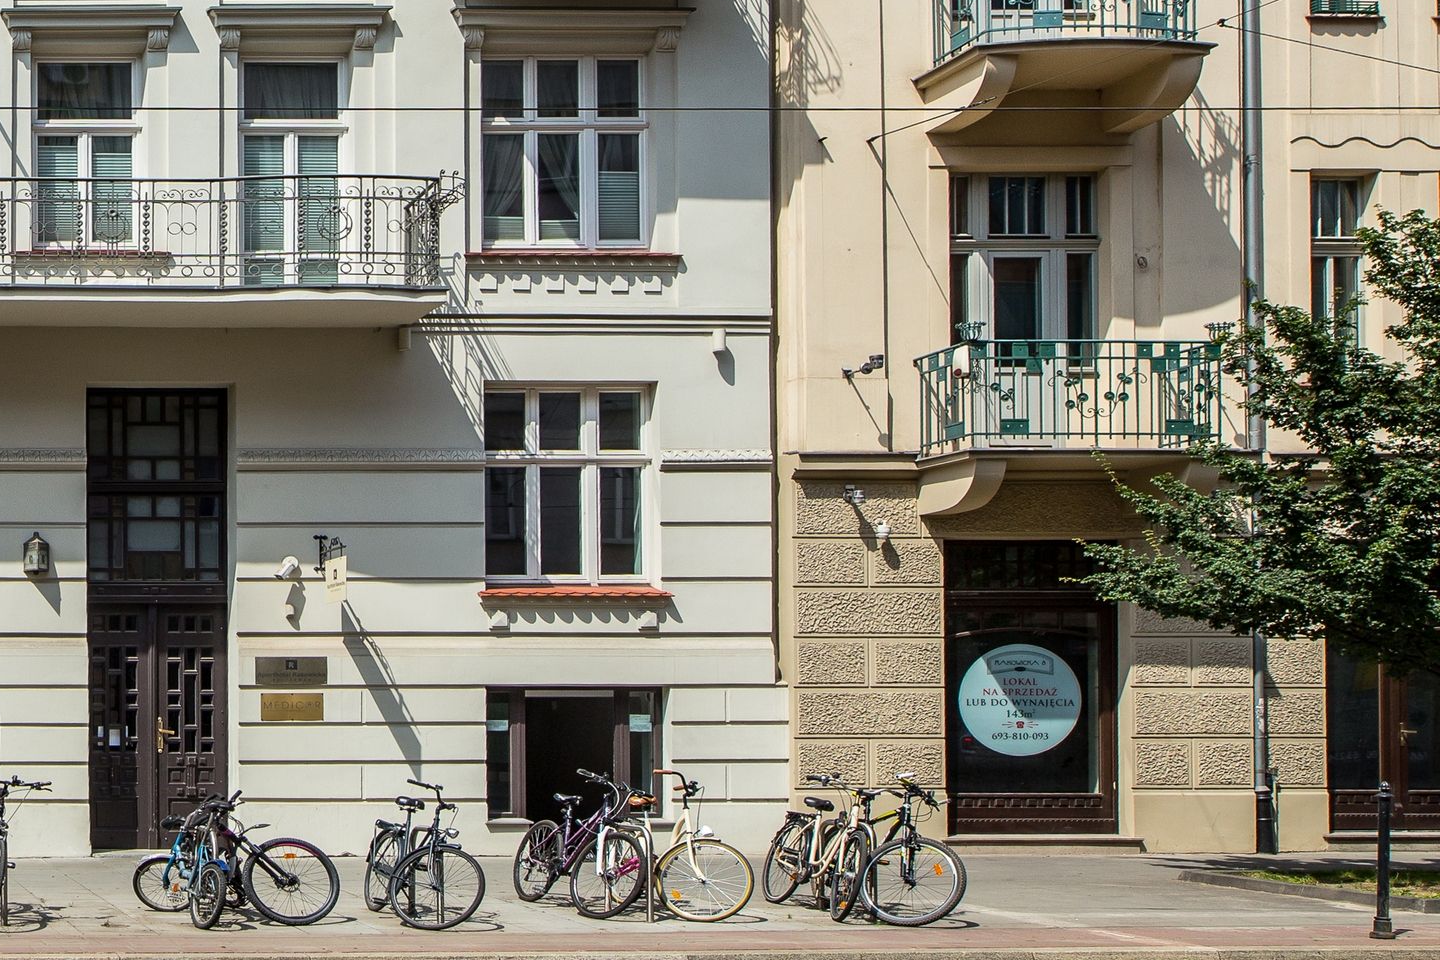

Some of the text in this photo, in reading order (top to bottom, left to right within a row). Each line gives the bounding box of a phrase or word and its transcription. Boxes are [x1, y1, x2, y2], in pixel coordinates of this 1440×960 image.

[1003, 677, 1038, 686] LOKAL
[982, 687, 1058, 696] NA SPRZEDAŻ
[966, 698, 1075, 708] LUB DO WYNAJĘCIA
[991, 732, 1049, 741] 693-810-093
